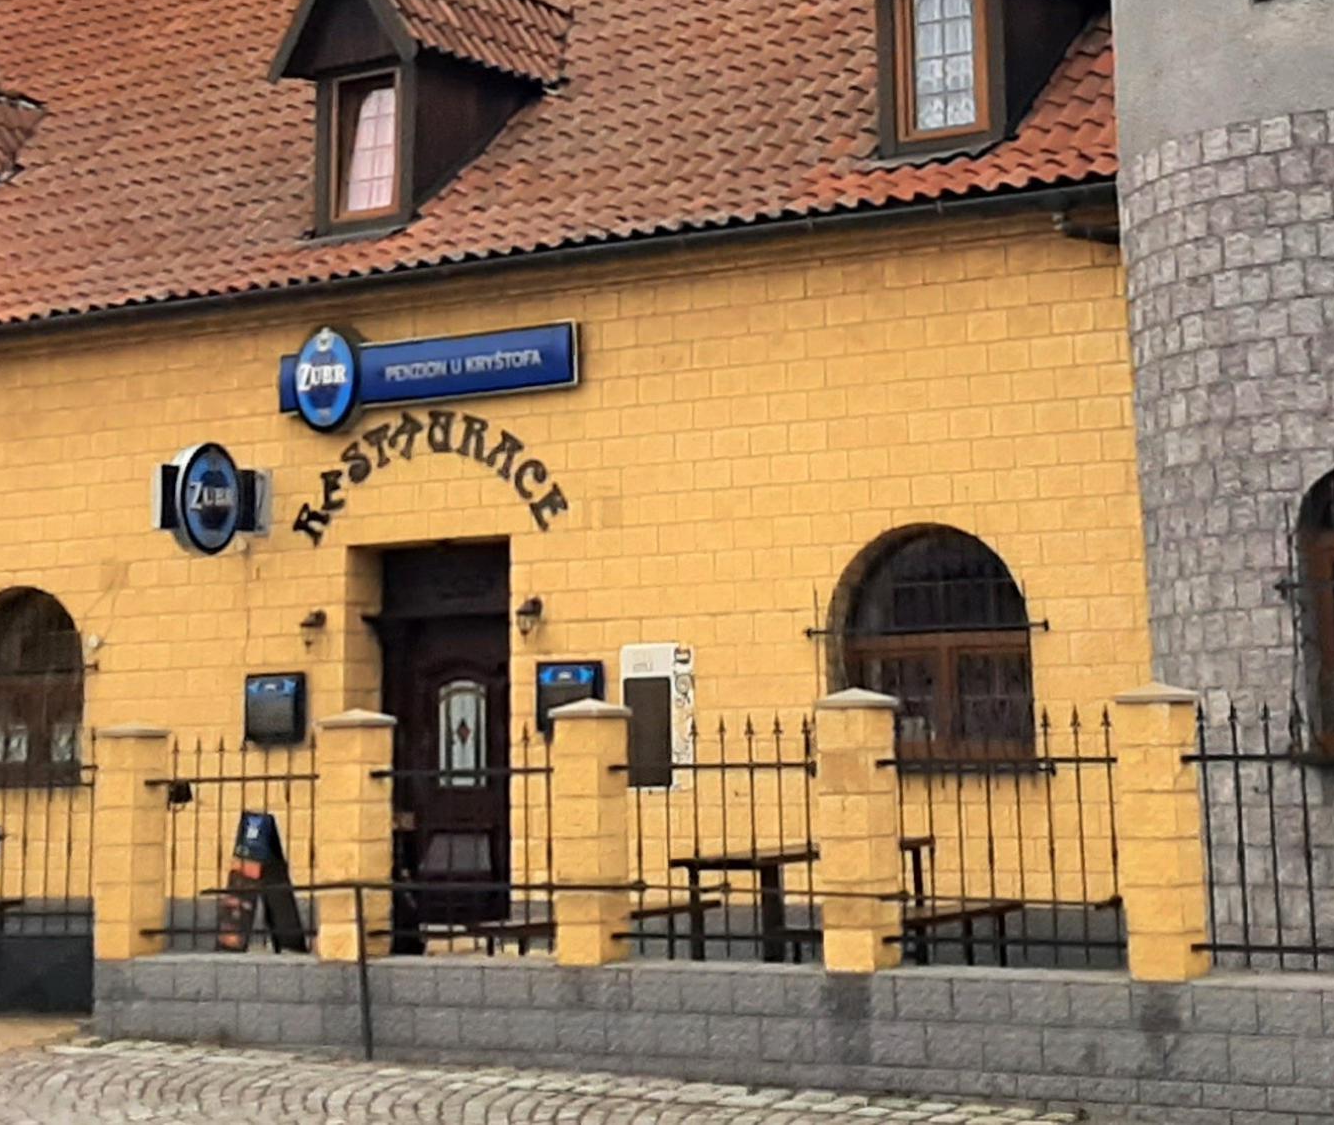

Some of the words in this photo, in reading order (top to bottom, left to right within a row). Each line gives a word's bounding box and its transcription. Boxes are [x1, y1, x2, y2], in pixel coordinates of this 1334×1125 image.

[384, 360, 447, 382] PENZION
[450, 357, 463, 375] U
[465, 349, 541, 373] KRYŠTOFA
[292, 410, 568, 547] RESTAURACE
